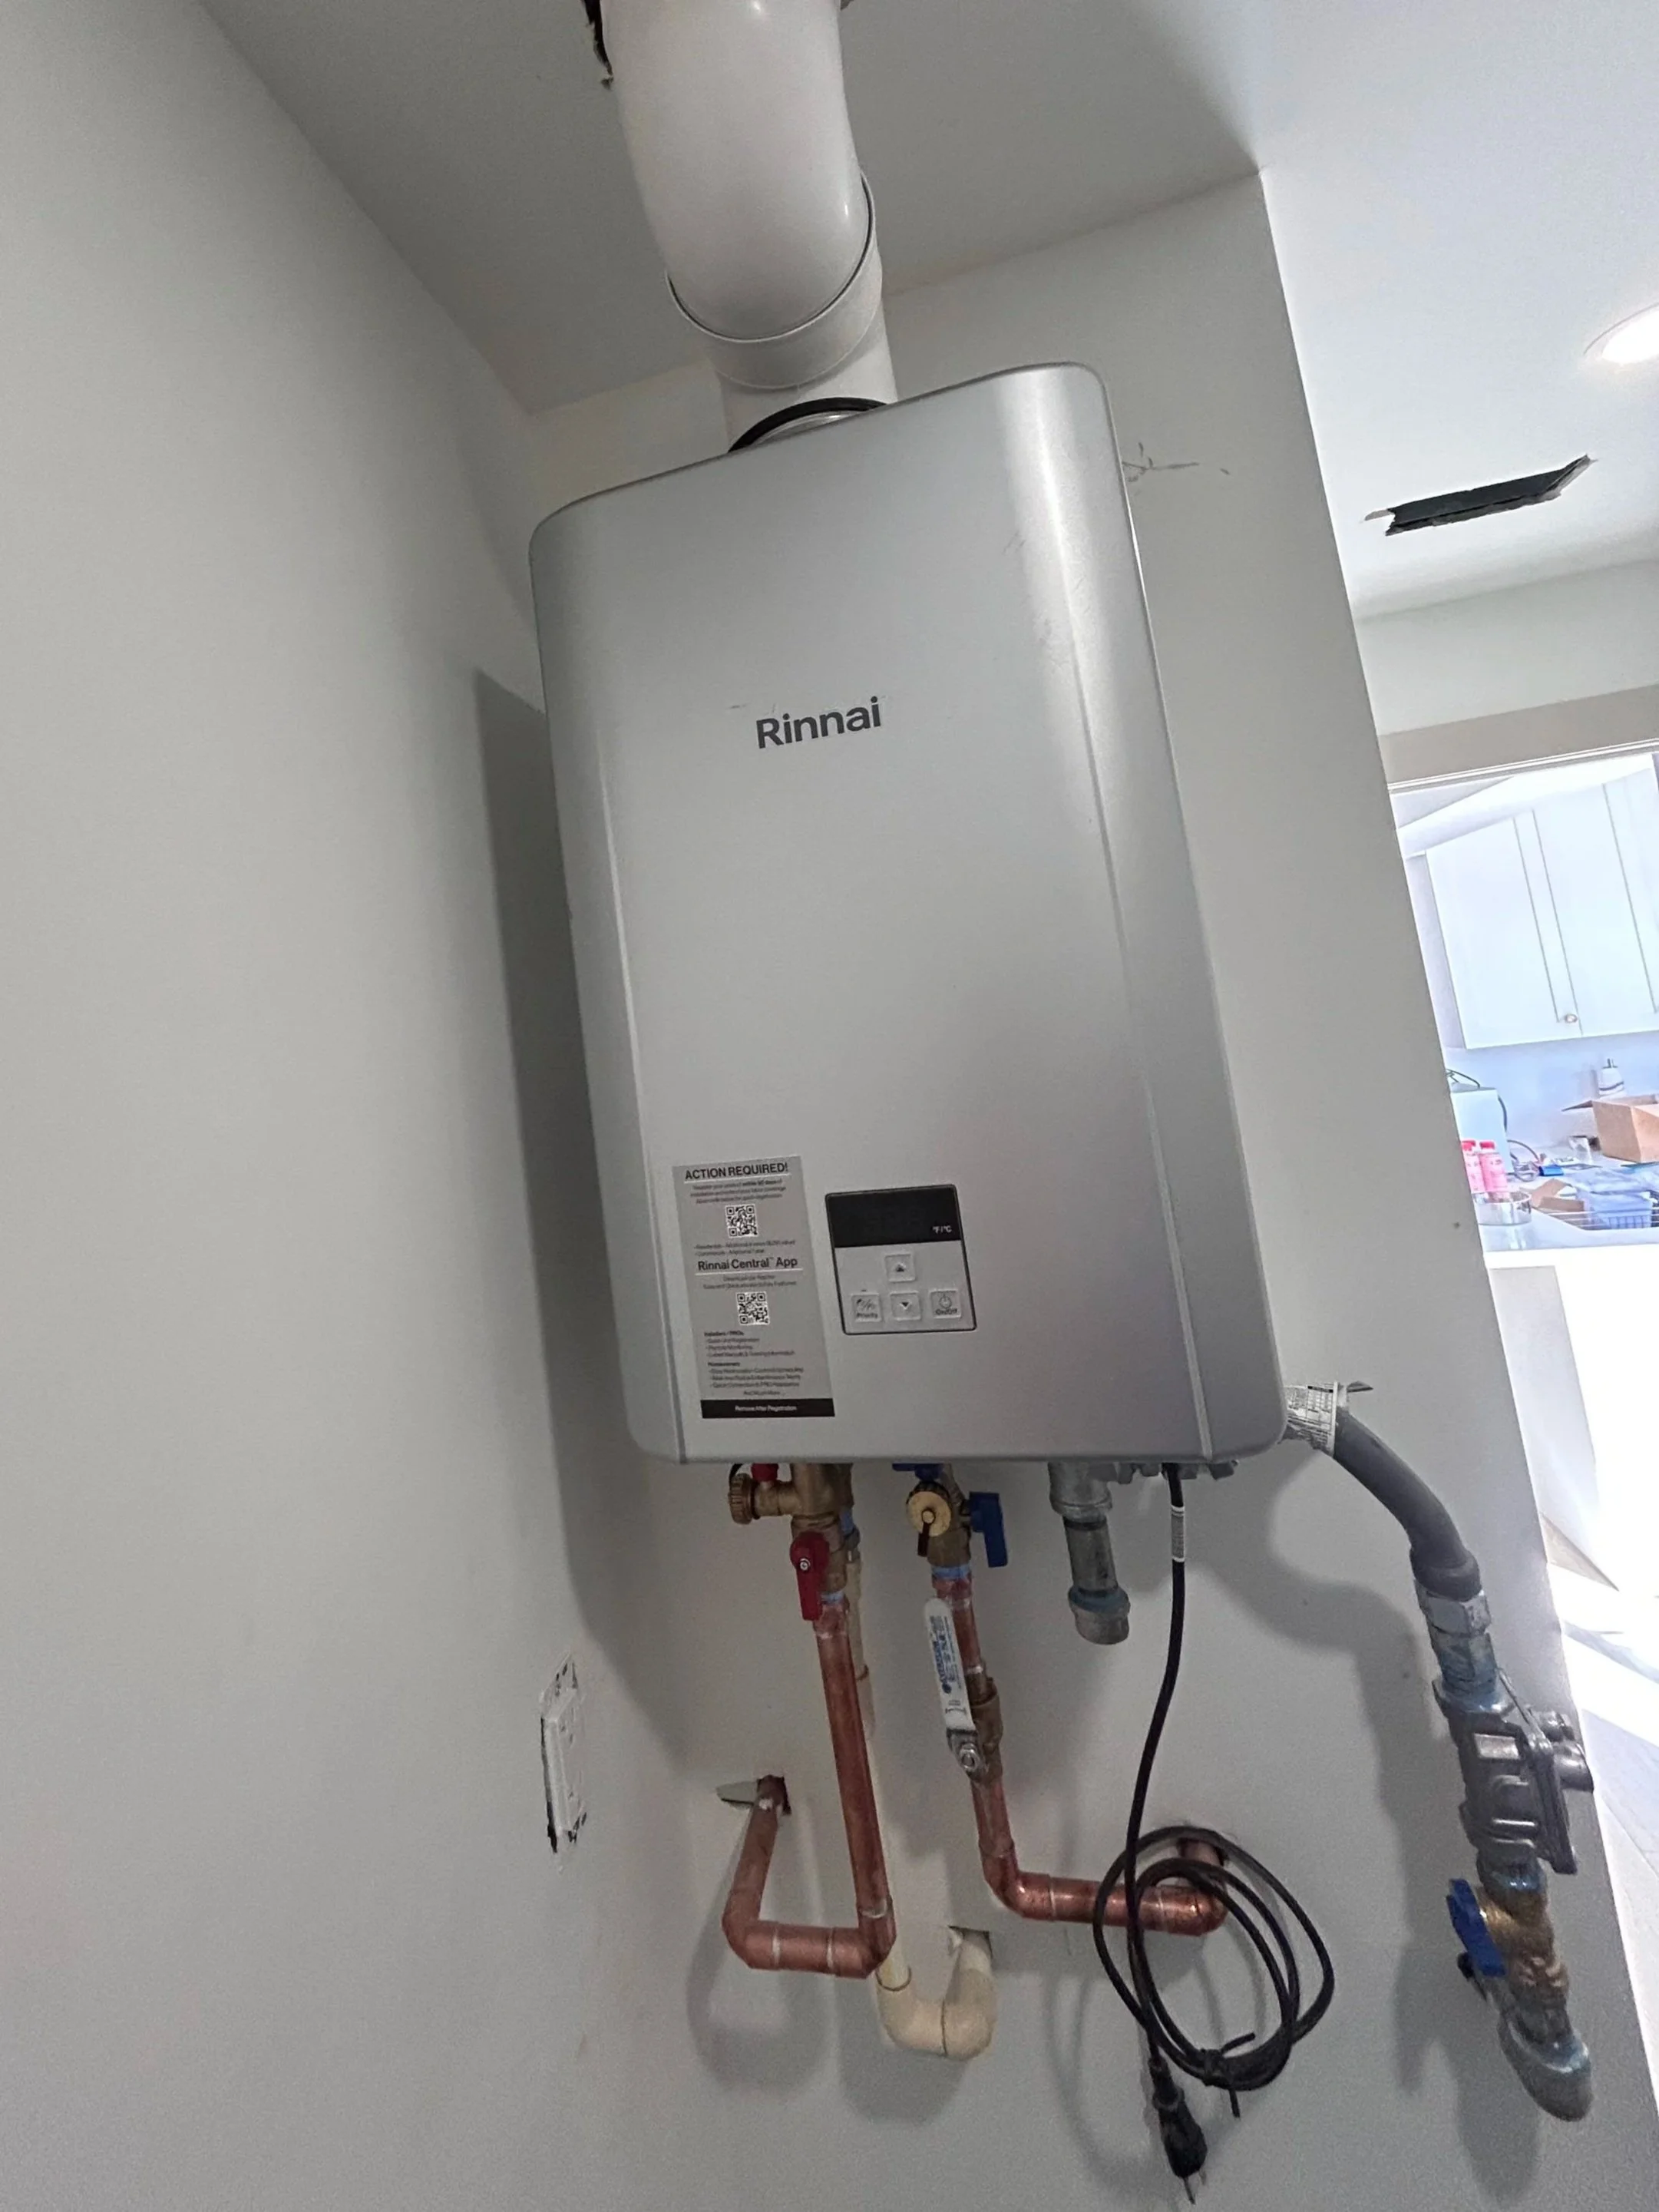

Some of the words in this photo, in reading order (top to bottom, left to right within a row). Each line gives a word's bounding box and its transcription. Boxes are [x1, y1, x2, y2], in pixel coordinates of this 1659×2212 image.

[756, 696, 881, 749] Rinnai
[685, 1167, 726, 1180] ACTION
[729, 1162, 788, 1177] REQUIRED!
[698, 1259, 729, 1271] Rinnai
[776, 1257, 798, 1268] App
